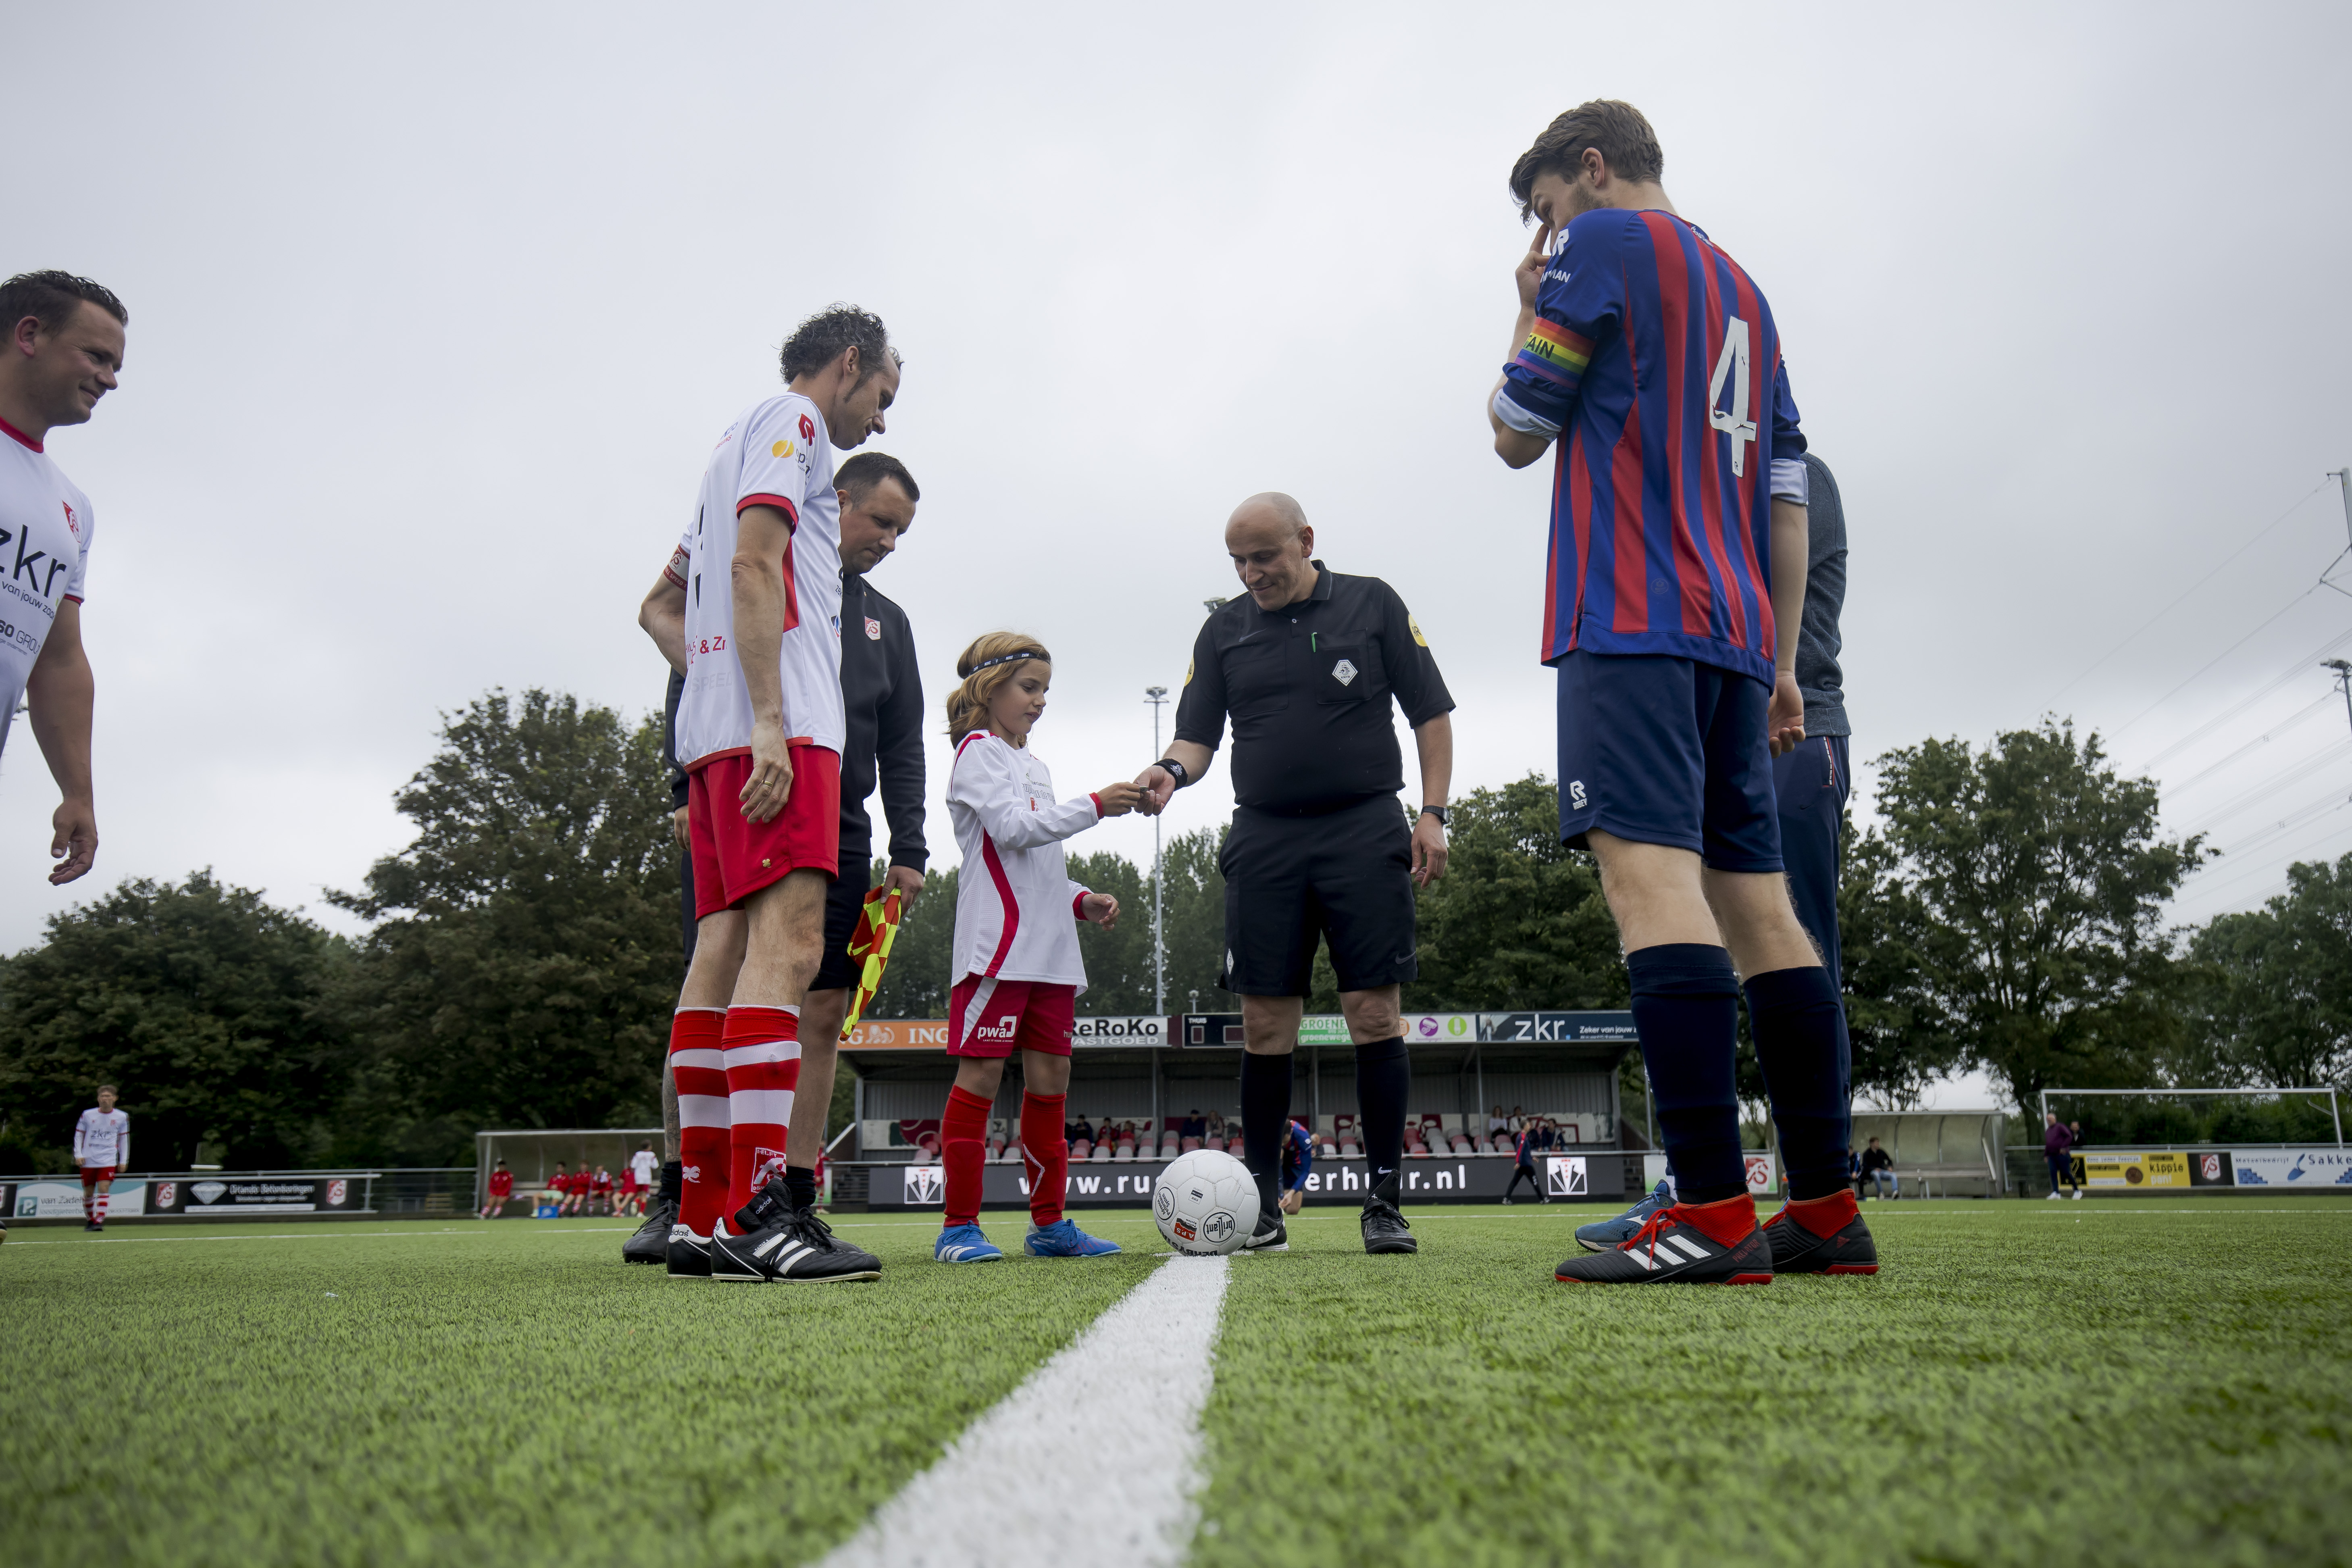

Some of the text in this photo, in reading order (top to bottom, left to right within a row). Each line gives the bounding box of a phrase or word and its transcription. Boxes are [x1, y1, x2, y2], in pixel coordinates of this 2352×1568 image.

[1709, 315, 1757, 477] 4
[669, 573, 684, 586] SPEED
[2, 581, 20, 597] van
[20, 589, 43, 609] jouw
[908, 1027, 949, 1044] ING
[1579, 1025, 1600, 1034] Zeker
[1615, 1025, 1632, 1035] jouw
[2235, 1156, 2289, 1165] Metselbedrijf
[756, 1196, 772, 1214] adidas
[1162, 1192, 1170, 1208] System
[1206, 1217, 1233, 1239] brillant
[1732, 1239, 1761, 1263] PREDATOR
